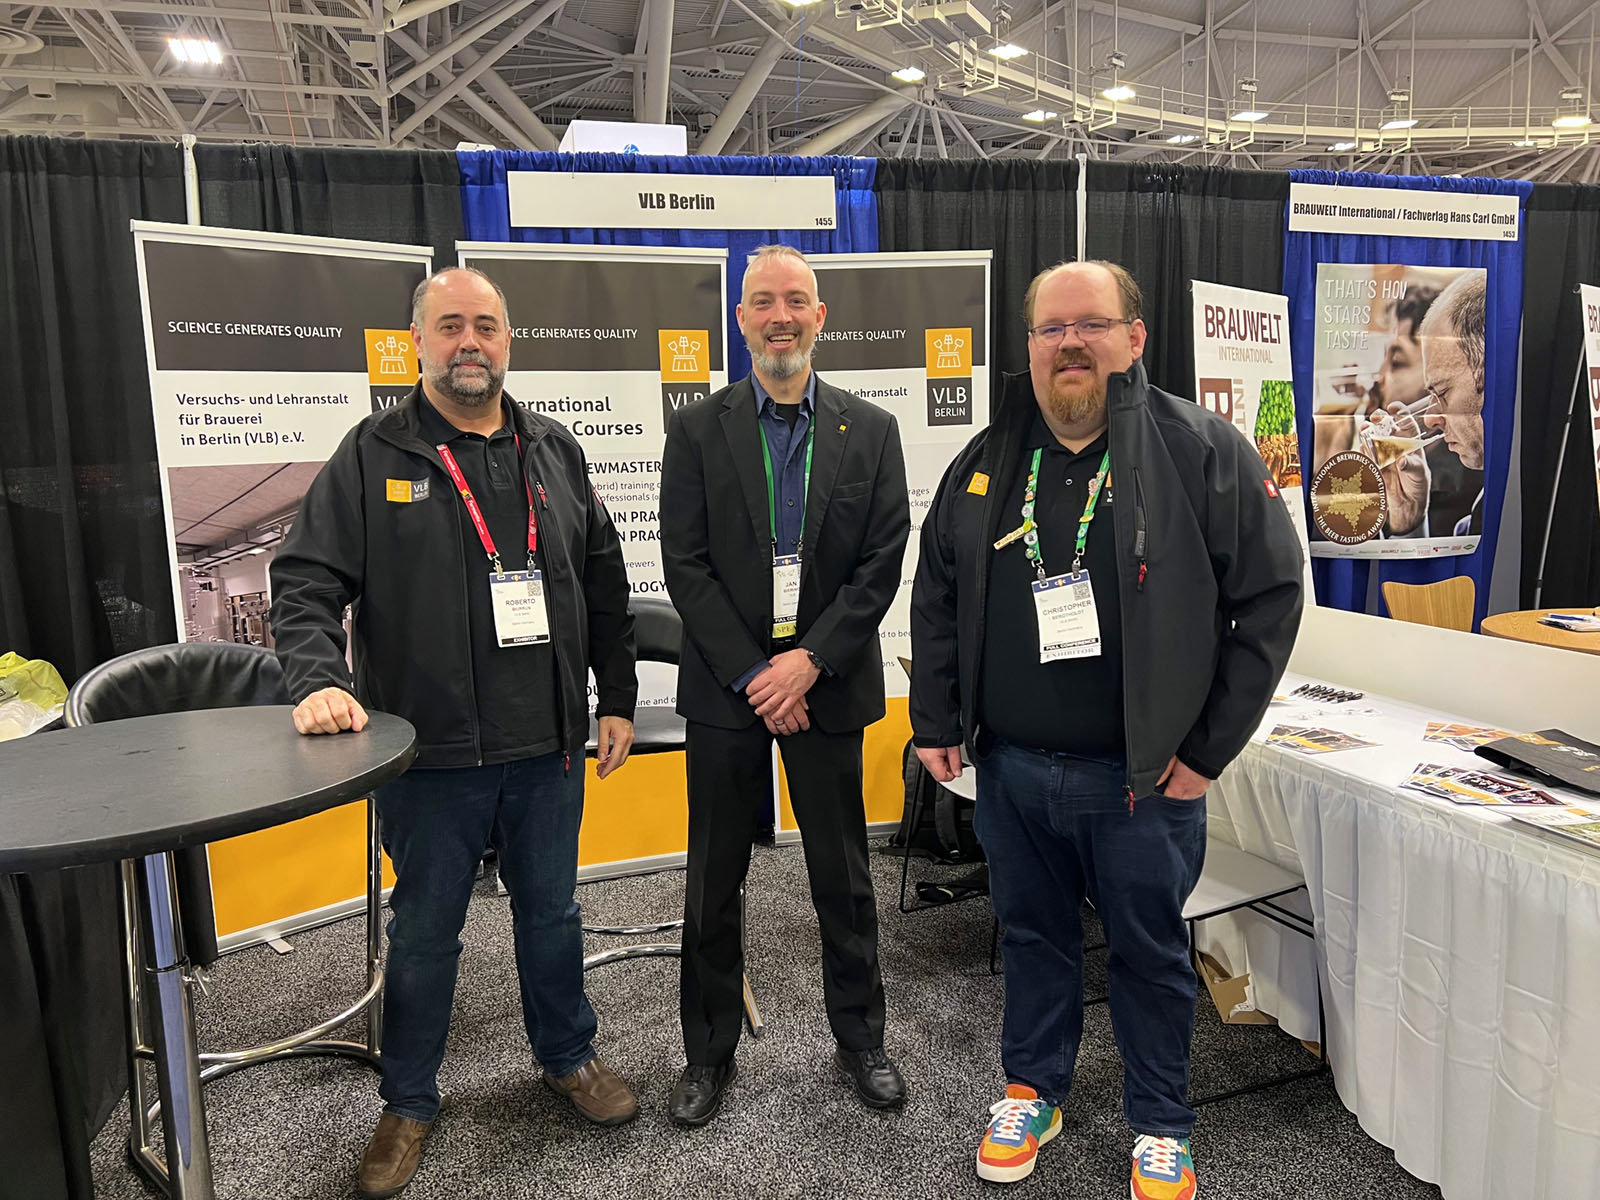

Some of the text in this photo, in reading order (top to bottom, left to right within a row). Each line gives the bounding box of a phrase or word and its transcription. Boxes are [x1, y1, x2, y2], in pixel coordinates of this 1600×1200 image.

[638, 193, 715, 210] VLB Berlin
[1294, 203, 1515, 225] BRAUWELT International / Fachverlag Hans Carl GmbH
[815, 217, 833, 226] 1455
[1325, 279, 1377, 299] THAT'S
[1324, 305, 1371, 324] STARS
[168, 321, 342, 338] SCIENCE GENERATES QUALITY
[1205, 304, 1281, 344] BRAUWELT
[531, 328, 591, 338] GENERATES
[593, 329, 638, 339] QUALITY
[867, 330, 906, 341] QUALITY
[1324, 330, 1369, 350] TASTE
[1219, 346, 1273, 363] INTERNATIONAL
[176, 393, 349, 405] Versuchs- und Lehranstalt
[932, 387, 967, 404] VLB
[518, 396, 612, 412] ernational
[178, 412, 263, 425] für Brauerei
[935, 407, 966, 417] BERLIN
[573, 420, 643, 436] Courses
[181, 431, 304, 446] in Berlin (VLB) e.V.
[587, 461, 662, 475] EWMASTER
[620, 481, 655, 491] training
[909, 488, 930, 497] rages
[1311, 461, 1337, 512] INTERNATIONAL
[1368, 464, 1386, 511] COMPETITION
[601, 493, 650, 502] ofessionals
[613, 511, 627, 523] IN
[1317, 513, 1384, 543] THE BEER TASTING AWARD
[630, 530, 662, 541] PRAC
[632, 581, 666, 593] LOGY
[505, 598, 536, 606] ROBERTO
[1042, 599, 1092, 616] CHRISTOPHER
[653, 696, 669, 705] and
